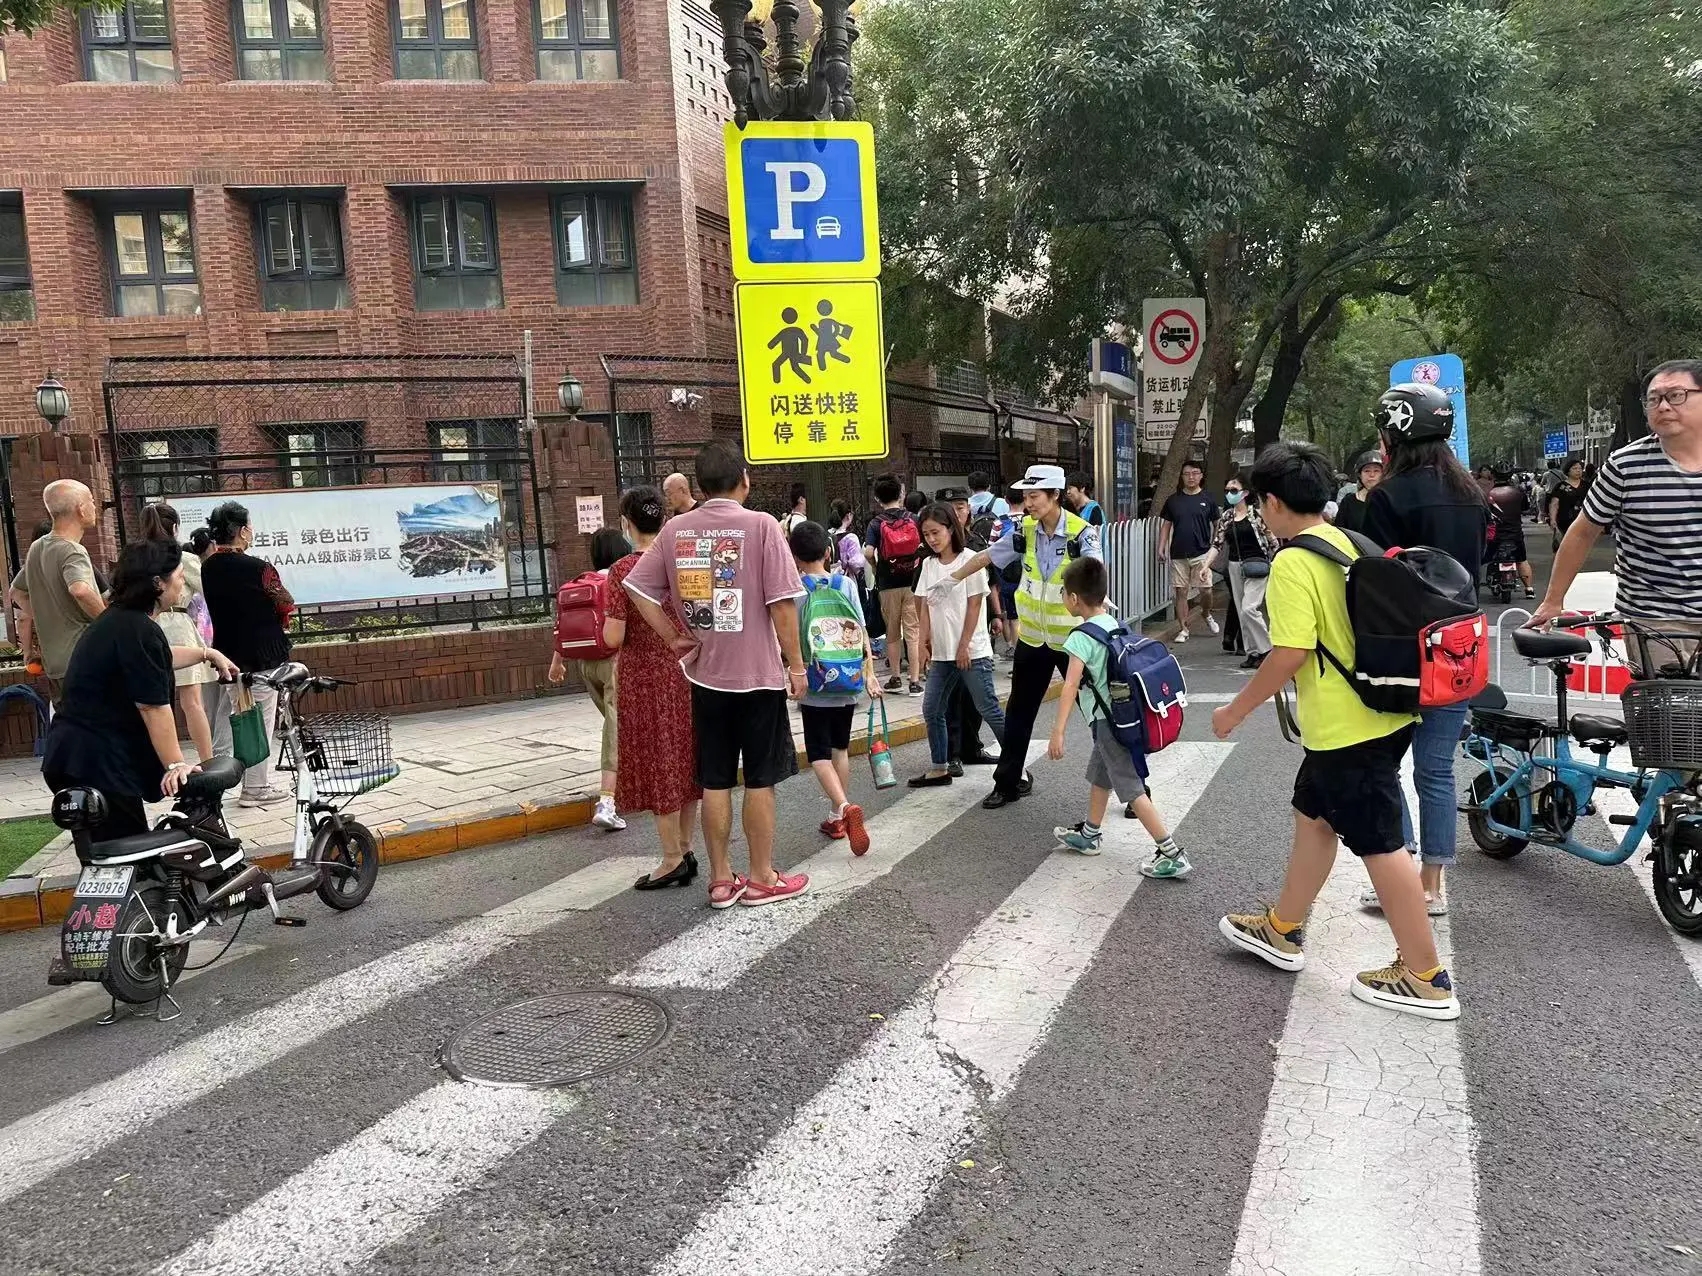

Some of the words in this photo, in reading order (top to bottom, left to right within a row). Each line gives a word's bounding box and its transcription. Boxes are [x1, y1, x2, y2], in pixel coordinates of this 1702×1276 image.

[765, 162, 826, 240] P
[770, 392, 859, 416] 闪送快接
[773, 419, 860, 445] 停靠点
[251, 530, 289, 548] 生活
[300, 526, 370, 545] 绿色出行
[675, 529, 698, 538] PIXEL
[702, 529, 746, 538] UNIVERSE
[252, 547, 392, 567] AAAAA级旅游景区
[679, 574, 699, 584] SMILE
[78, 881, 125, 894] 0230976
[67, 902, 121, 931] 小赵
[64, 930, 113, 943] 电动车维修
[64, 941, 111, 953] 配件批发
